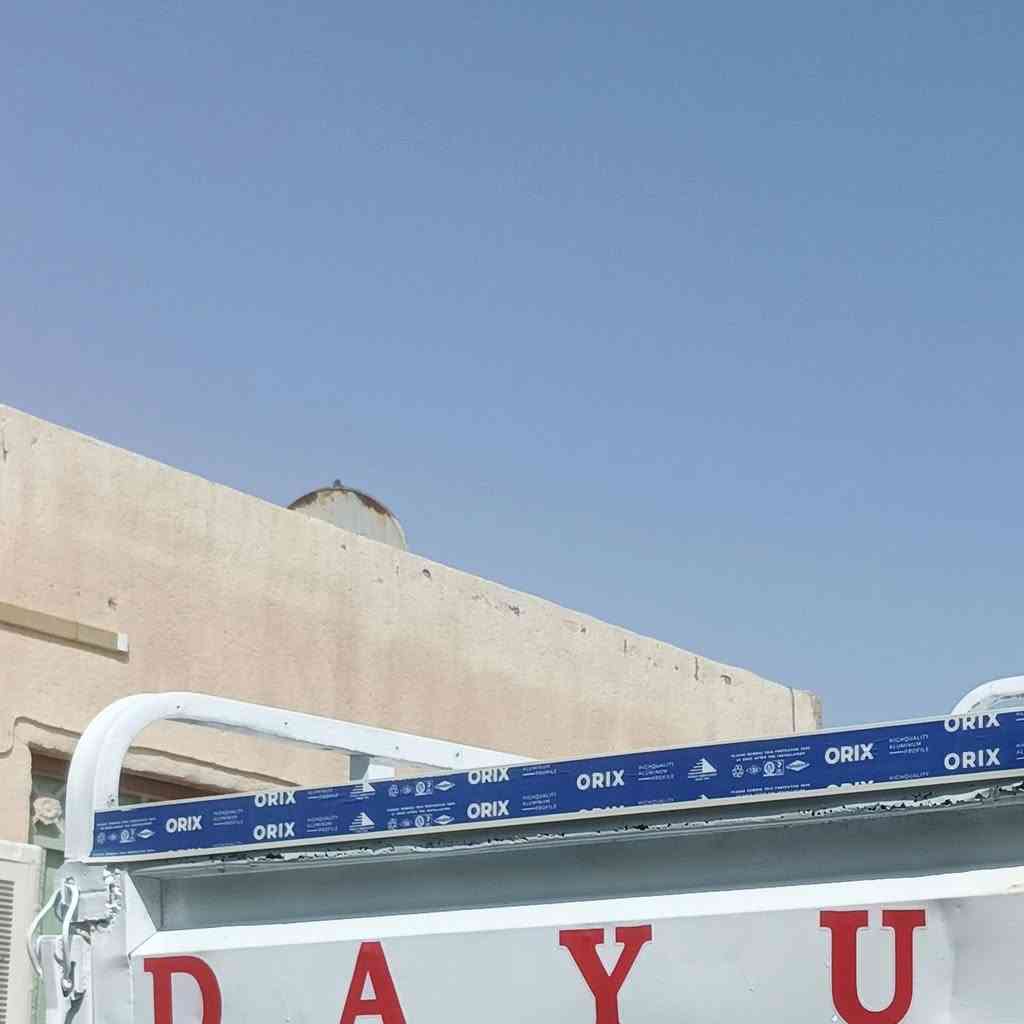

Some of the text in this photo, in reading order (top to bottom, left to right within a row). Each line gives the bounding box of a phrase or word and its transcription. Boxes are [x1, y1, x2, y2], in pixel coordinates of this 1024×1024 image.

[944, 712, 1000, 732] ORIX
[825, 743, 874, 764] ORIX
[944, 748, 1000, 770] ORIX
[467, 767, 510, 785] ORIX
[577, 769, 625, 790] ORIX
[254, 791, 297, 808] ORIX
[467, 800, 510, 819] ORIX
[165, 815, 203, 833] ORIX
[253, 822, 296, 841] ORIX
